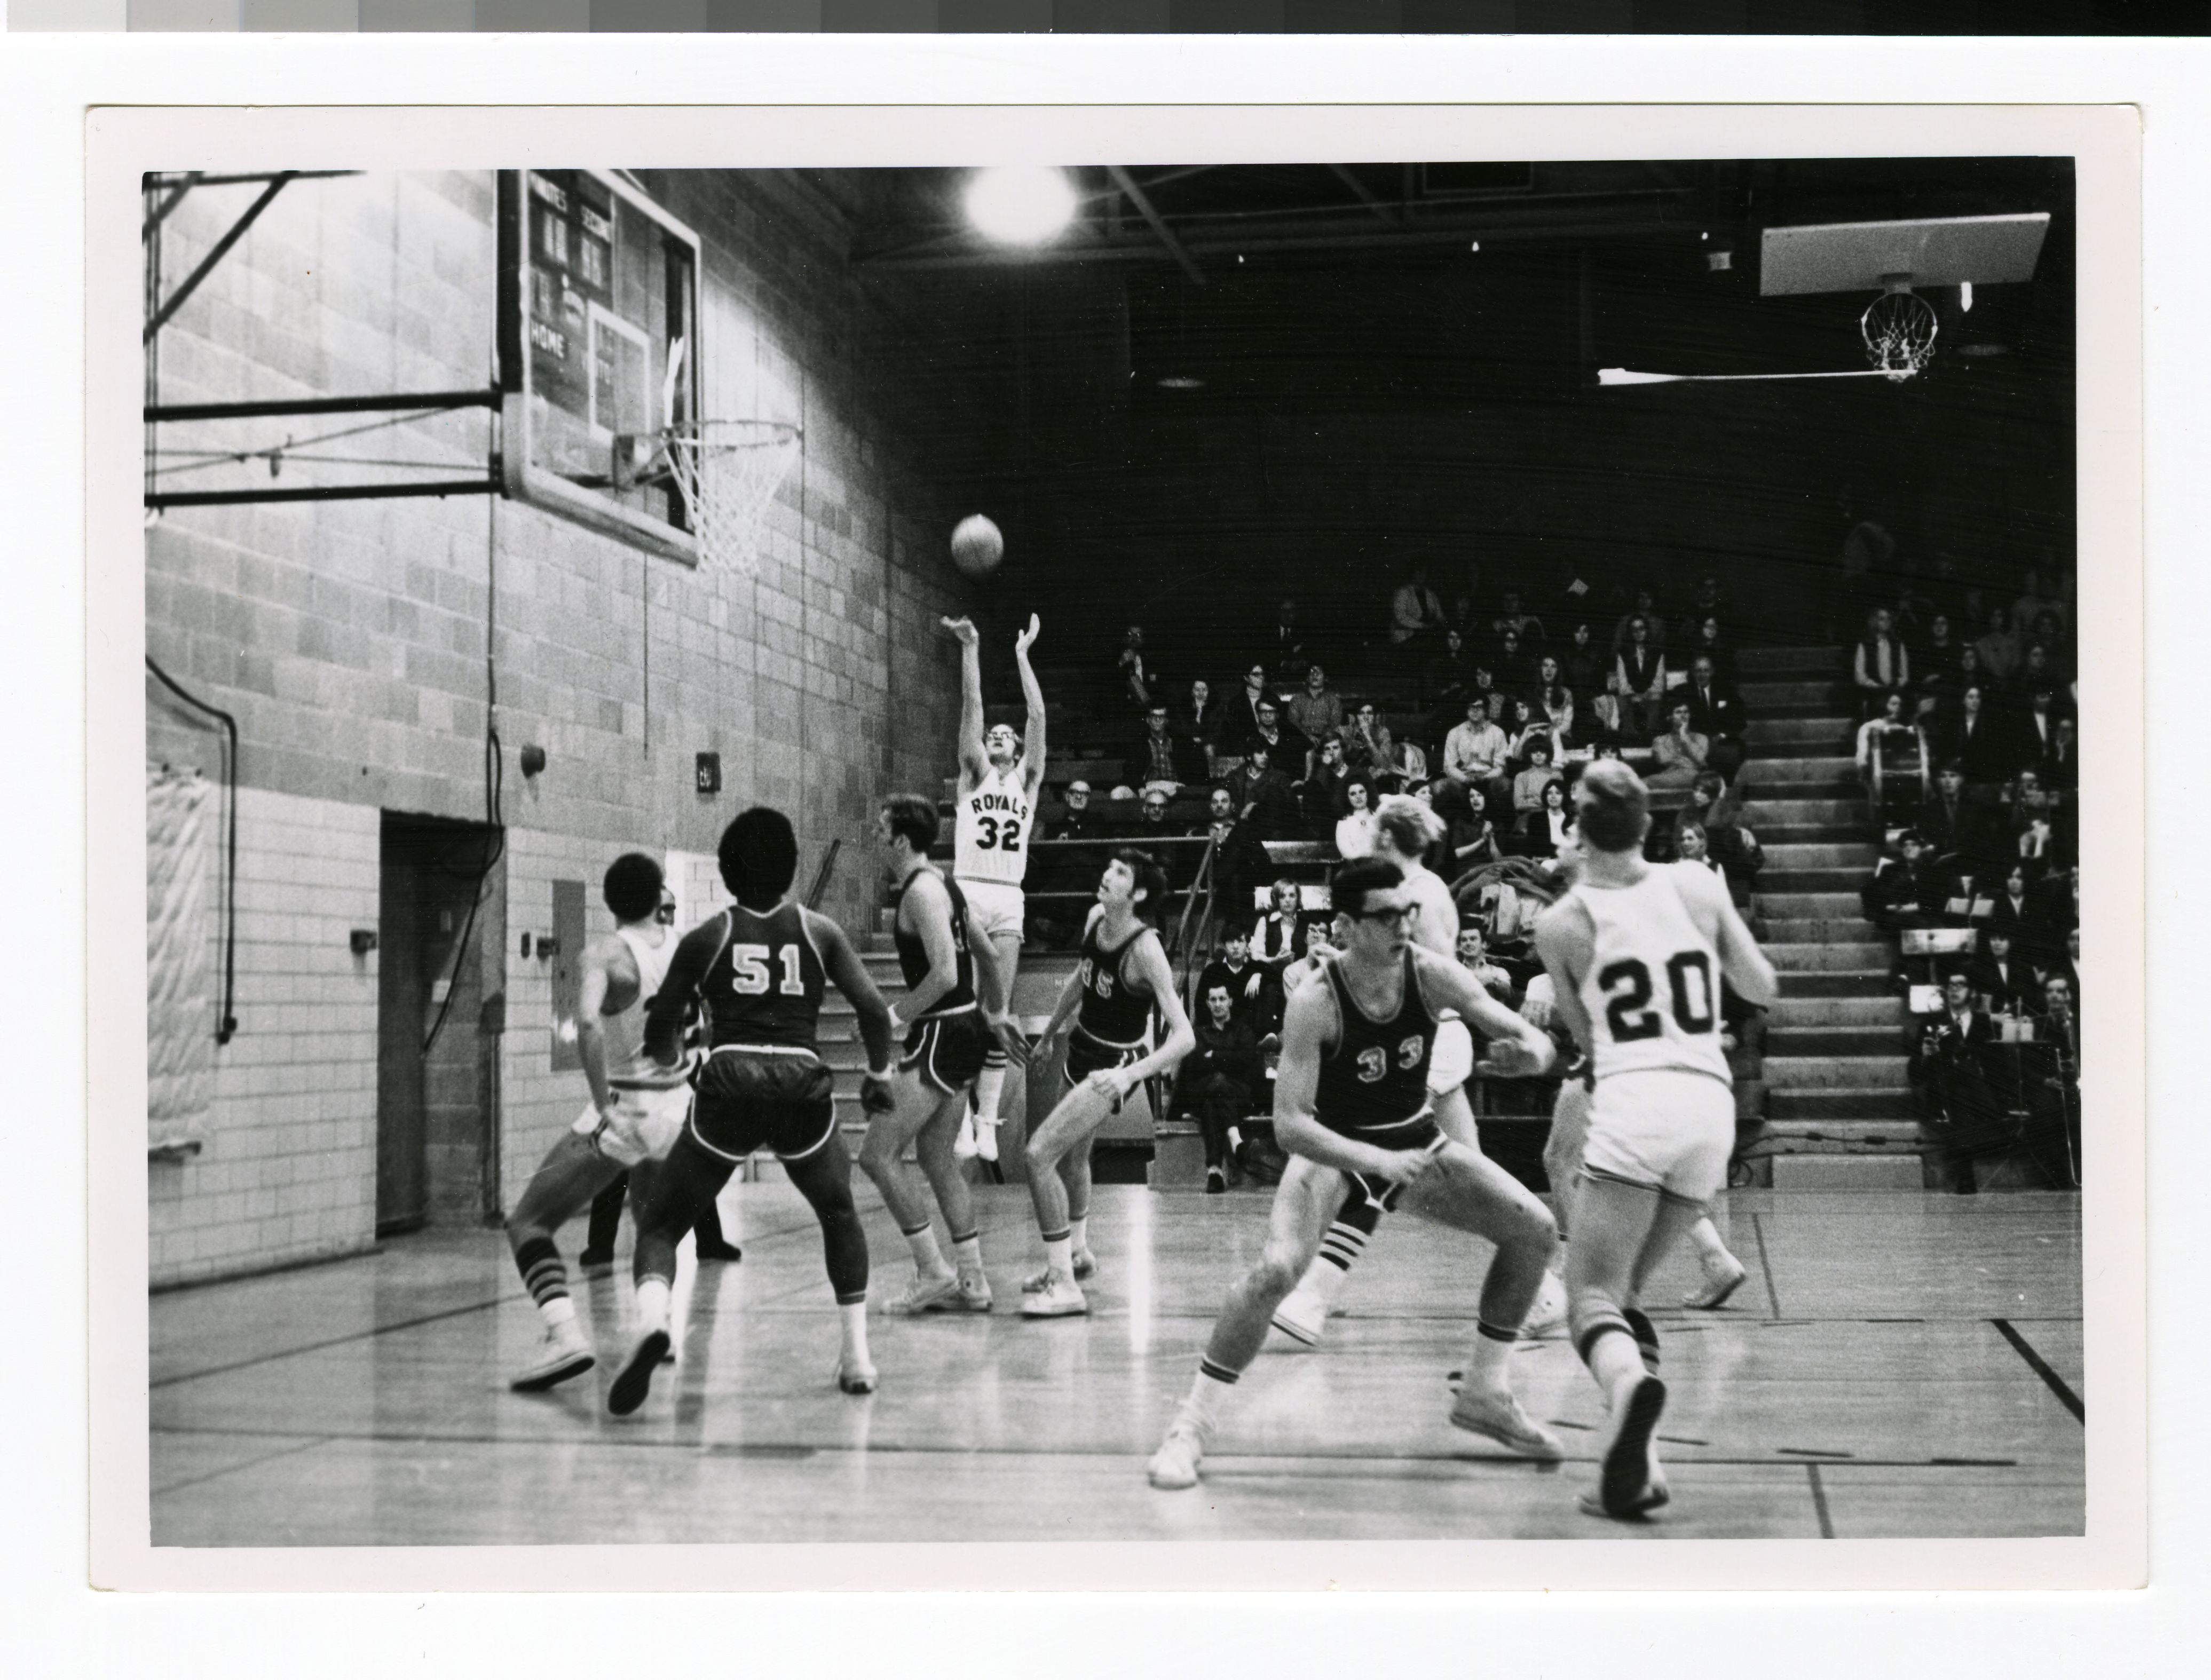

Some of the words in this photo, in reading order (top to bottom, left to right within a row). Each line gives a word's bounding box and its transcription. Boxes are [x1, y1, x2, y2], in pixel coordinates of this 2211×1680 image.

[531, 321, 565, 359] HOME
[971, 794, 1028, 820] ROYALS
[976, 816, 1020, 852] 32
[732, 943, 804, 996] 51
[1598, 949, 1715, 1043] 20
[1357, 1034, 1424, 1083] 33
